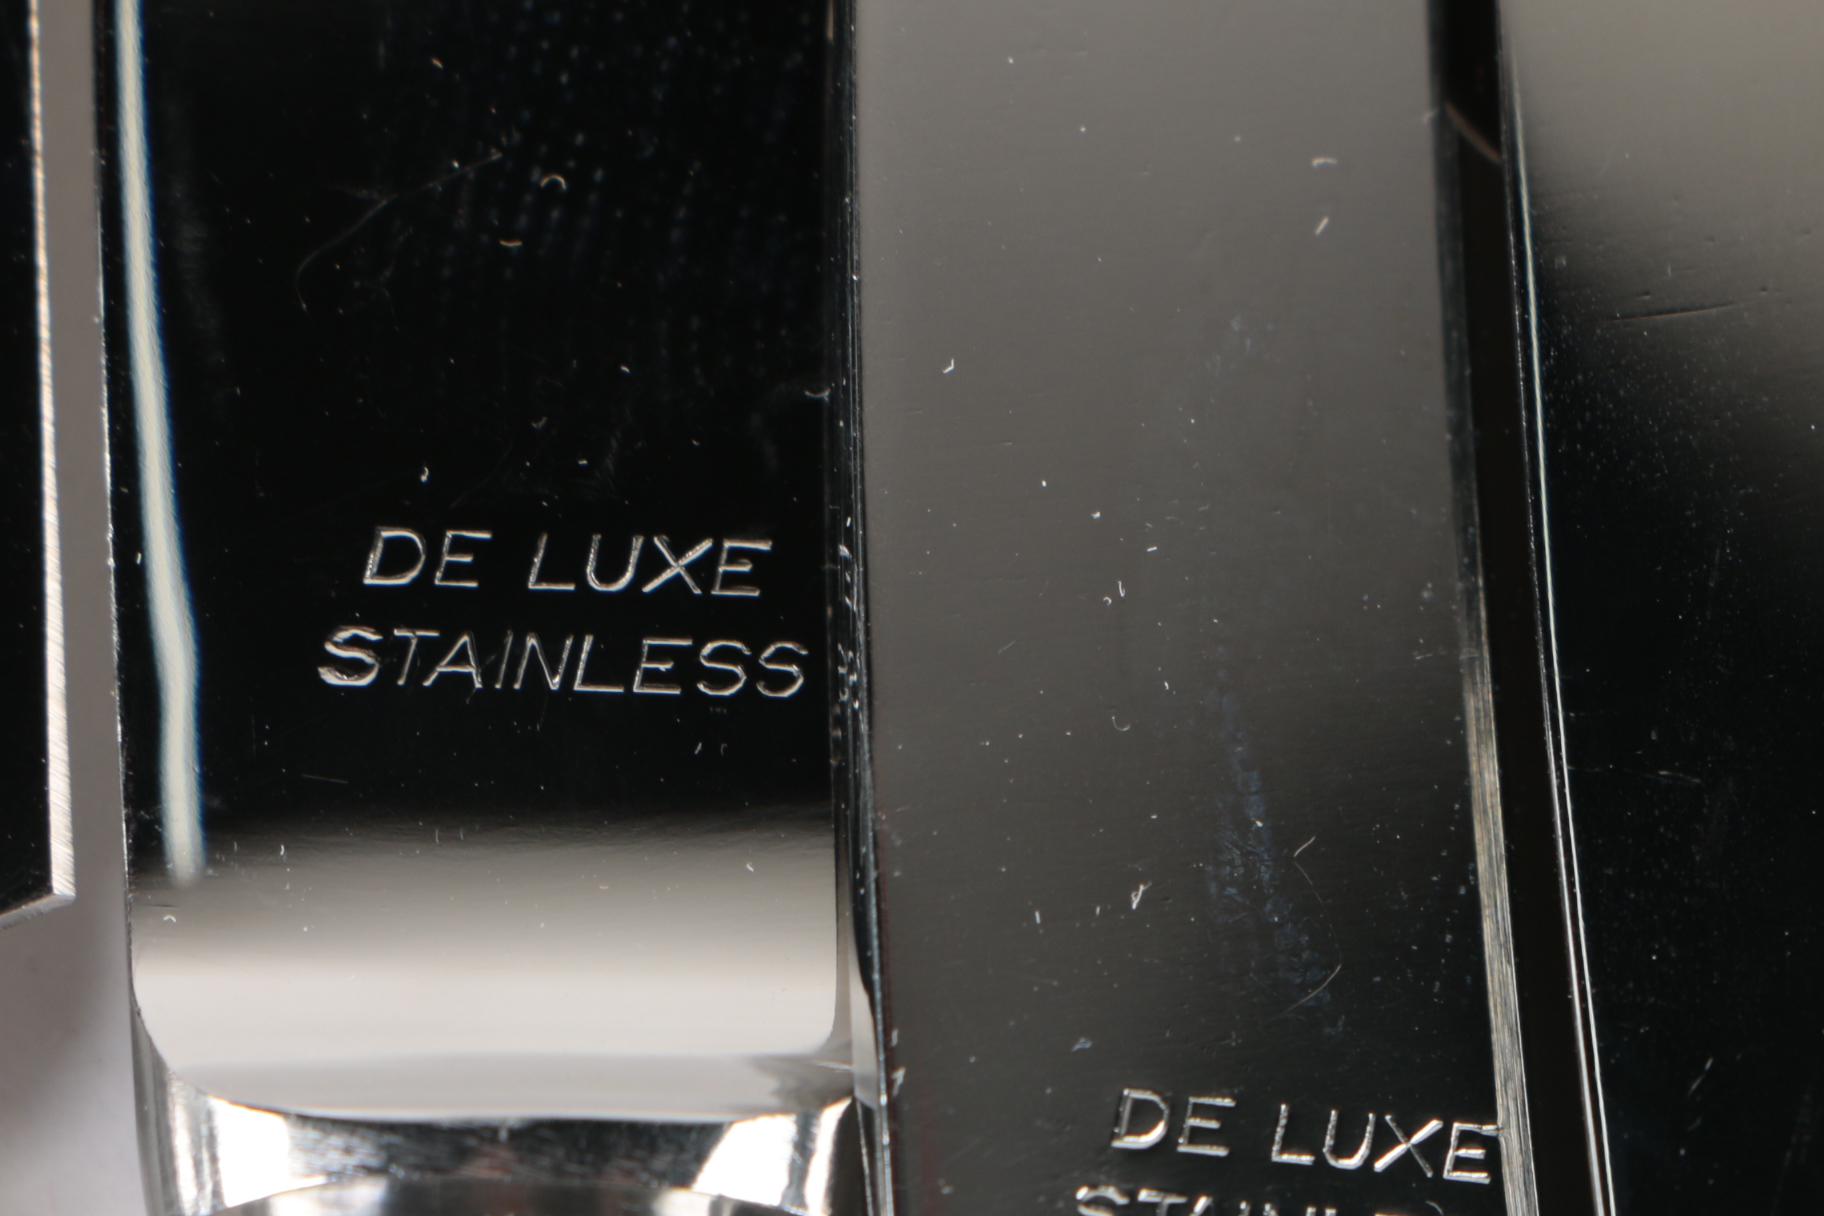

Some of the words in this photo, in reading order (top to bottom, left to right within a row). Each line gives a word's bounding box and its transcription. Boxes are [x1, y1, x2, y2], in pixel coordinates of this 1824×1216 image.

[363, 525, 493, 588] DE
[527, 533, 774, 598] LUXE
[317, 625, 809, 699] STAINLESS
[1111, 1087, 1236, 1158] DE
[1271, 1102, 1504, 1185] LUXE
